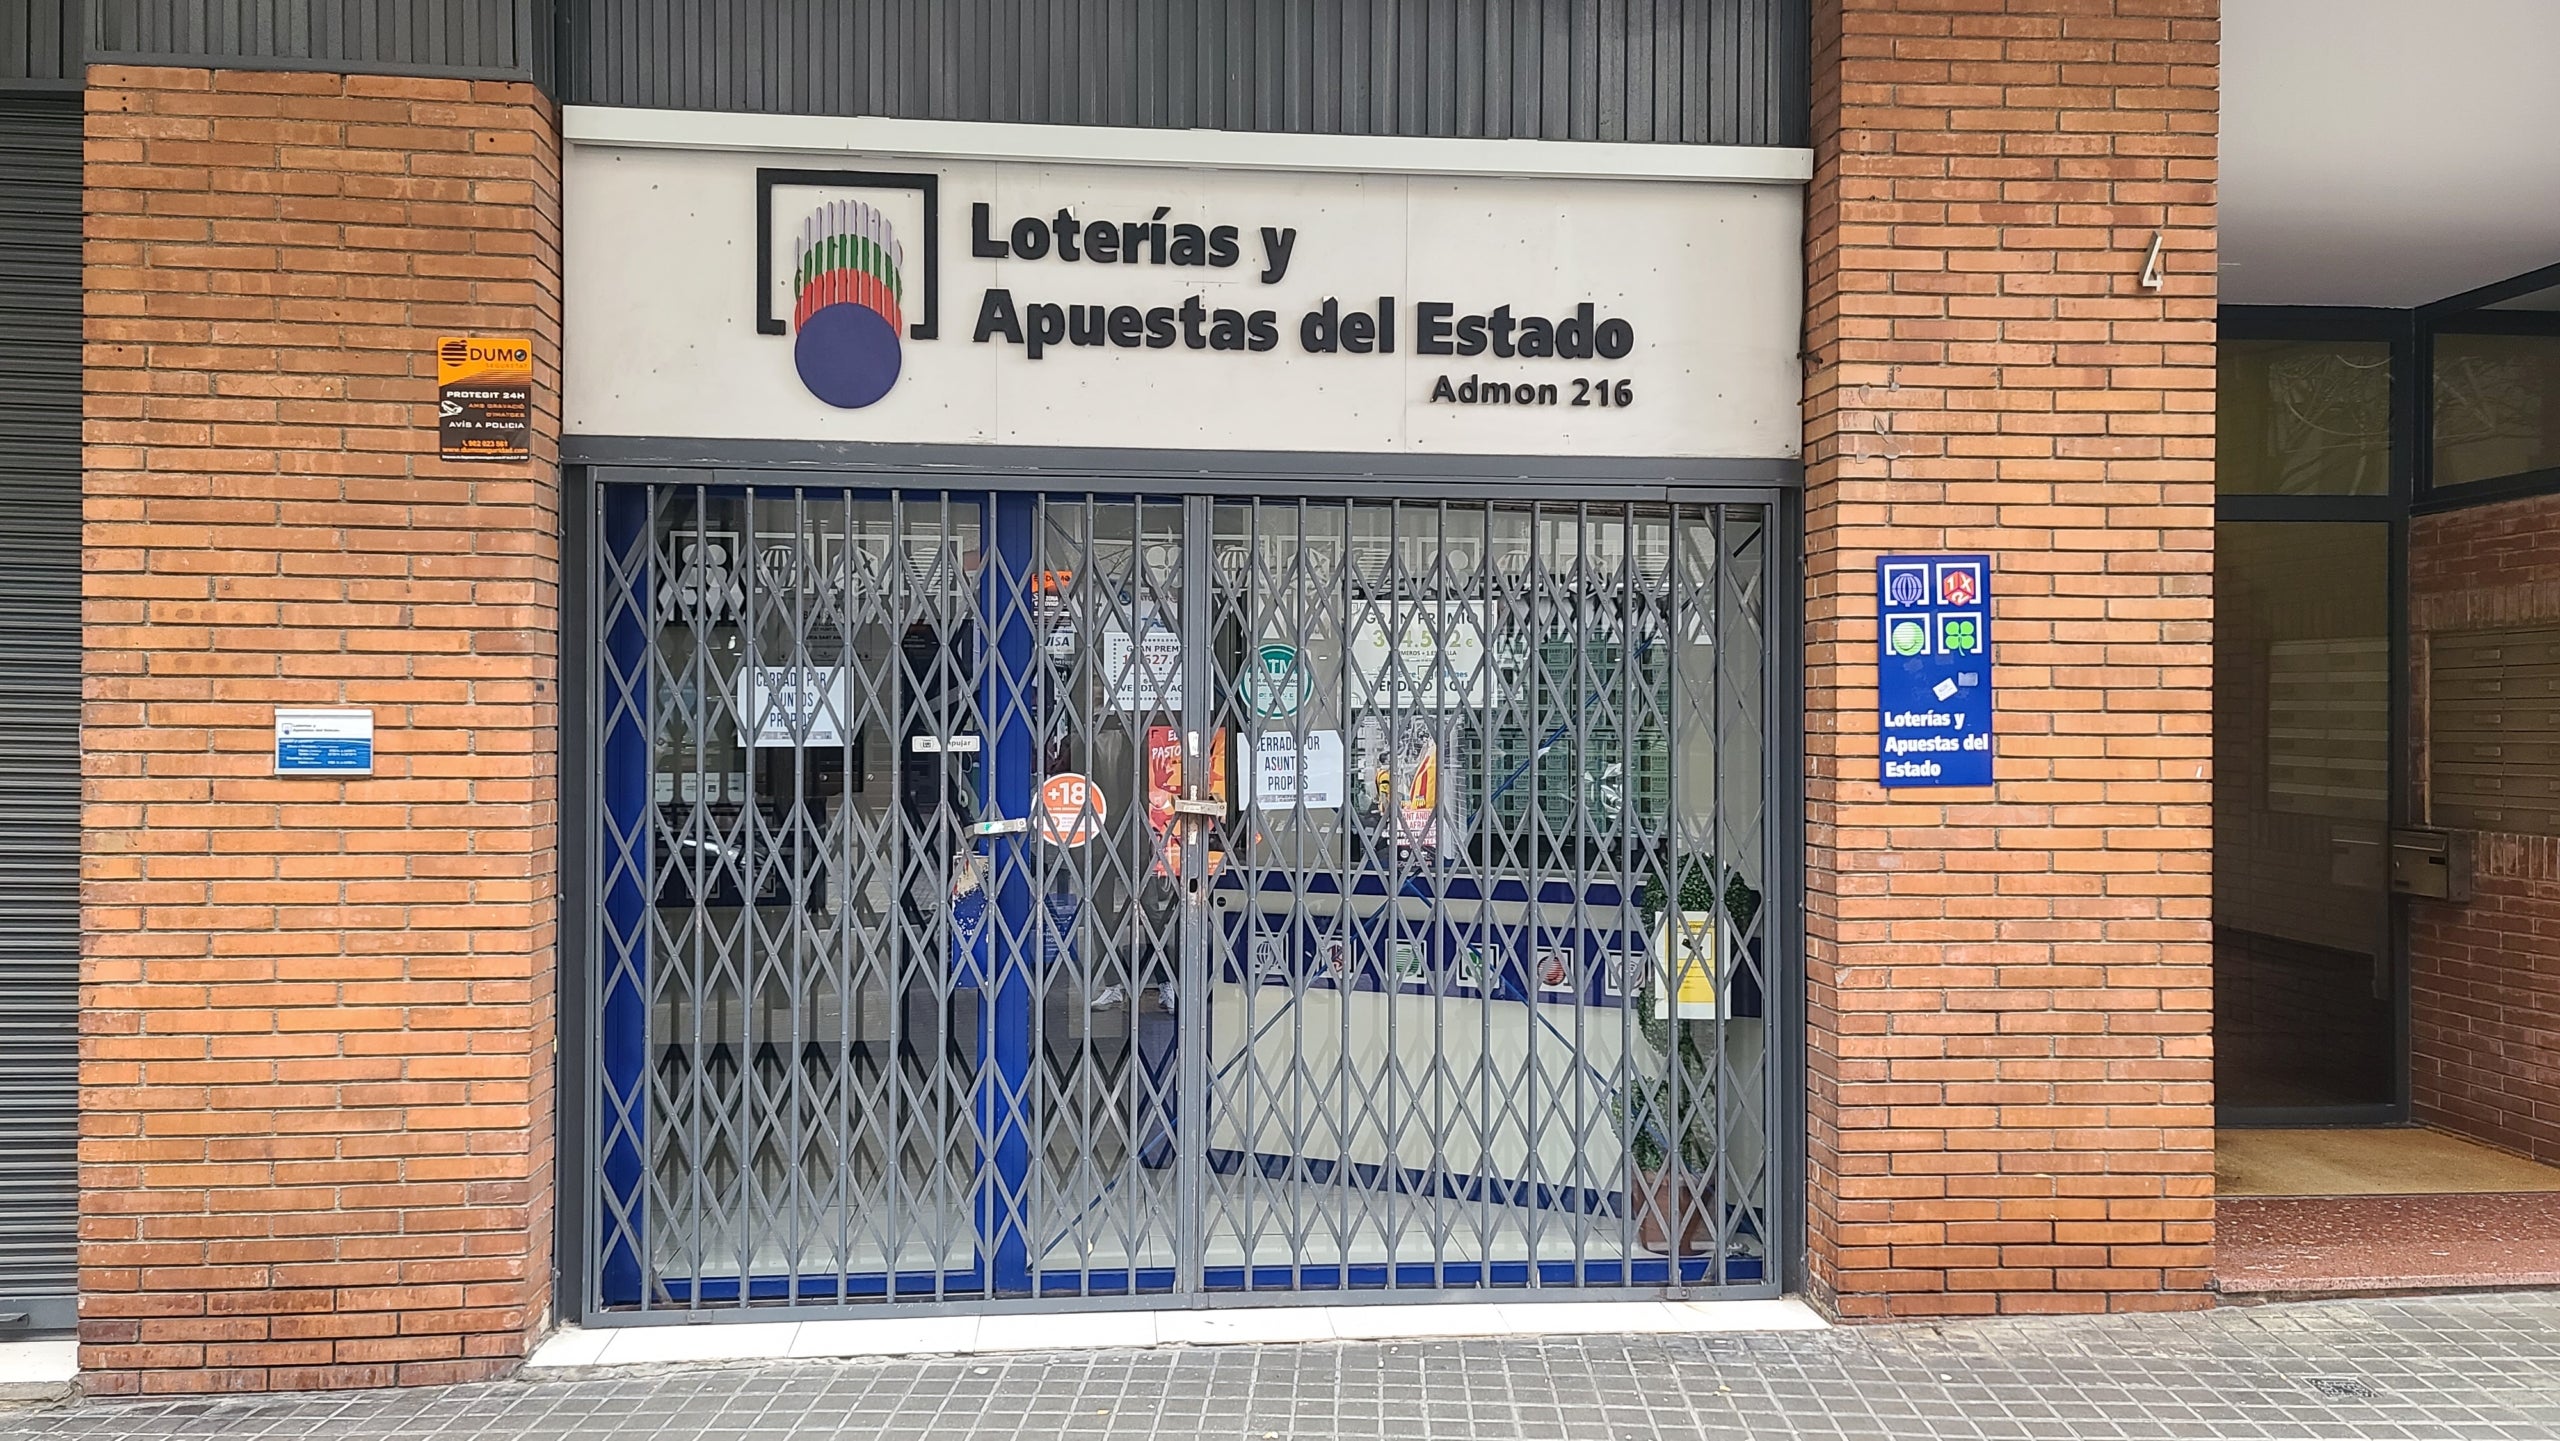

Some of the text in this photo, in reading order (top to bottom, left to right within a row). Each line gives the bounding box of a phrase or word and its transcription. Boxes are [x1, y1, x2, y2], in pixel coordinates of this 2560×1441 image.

[972, 203, 1297, 285] Loterías y
[2143, 235, 2163, 292] 4
[973, 289, 1634, 360] Apuestas del Estado
[470, 348, 527, 361] DUMO
[446, 391, 499, 399] PROTEGIT
[1430, 374, 1634, 407] Admon 216
[1885, 710, 1966, 730] Loterías y
[1885, 734, 1989, 756] Apuestas del
[1265, 756, 1308, 771] ASUNTS
[1886, 760, 1941, 777] Estado
[1268, 775, 1308, 790] PROPIS
